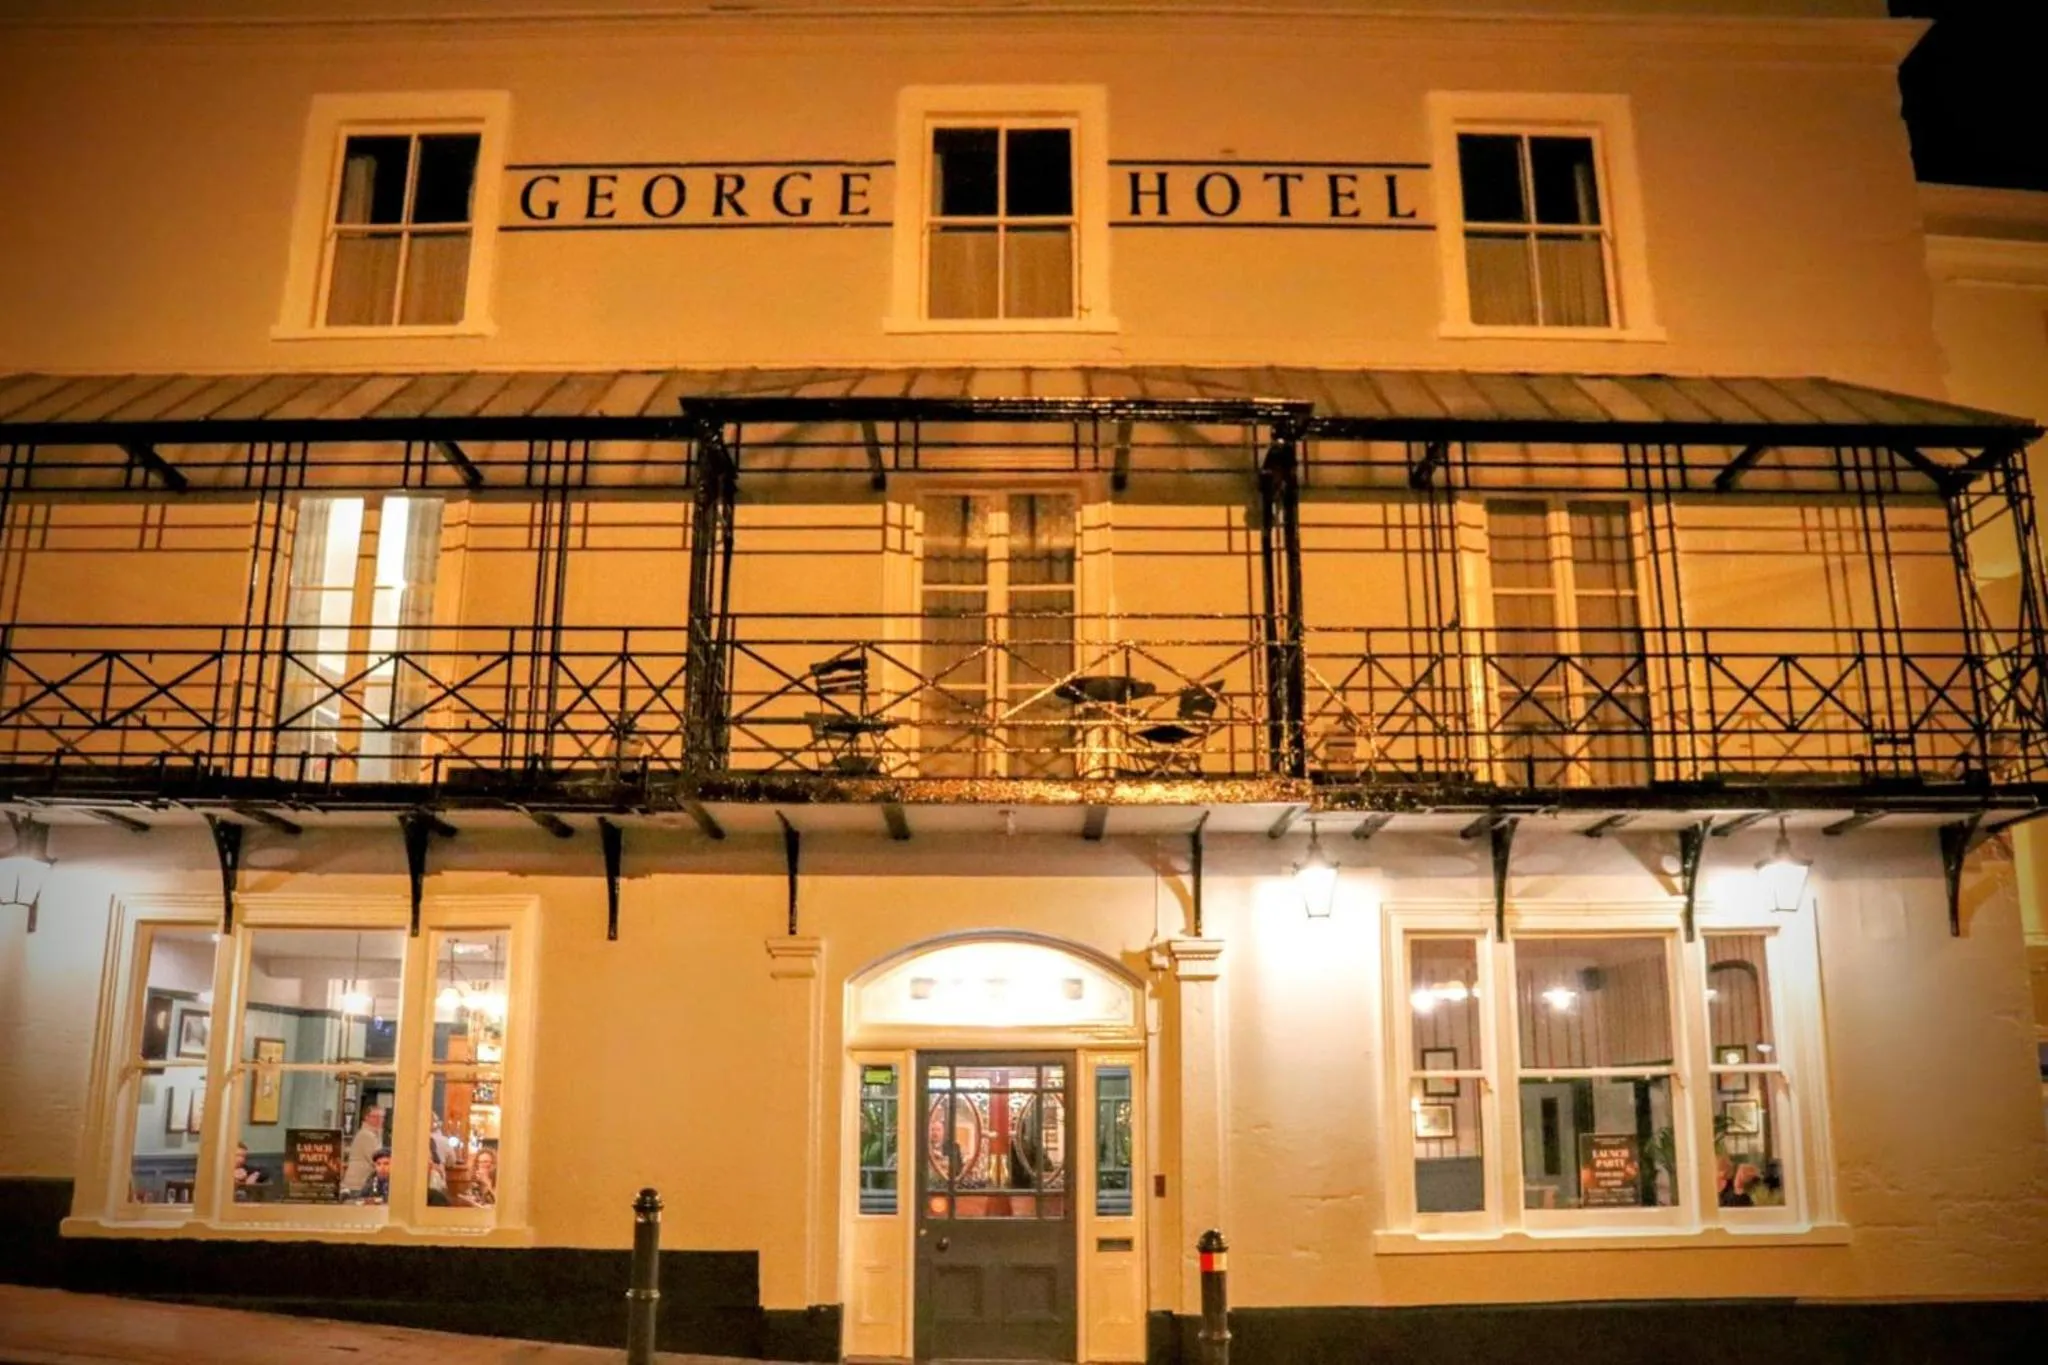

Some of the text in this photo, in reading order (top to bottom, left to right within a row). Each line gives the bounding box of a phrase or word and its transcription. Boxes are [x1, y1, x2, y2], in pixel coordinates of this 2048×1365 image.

[519, 171, 1417, 220] GEORGE HOTEL
[299, 1153, 328, 1163] PARTY
[1595, 1159, 1625, 1168] PARTY
